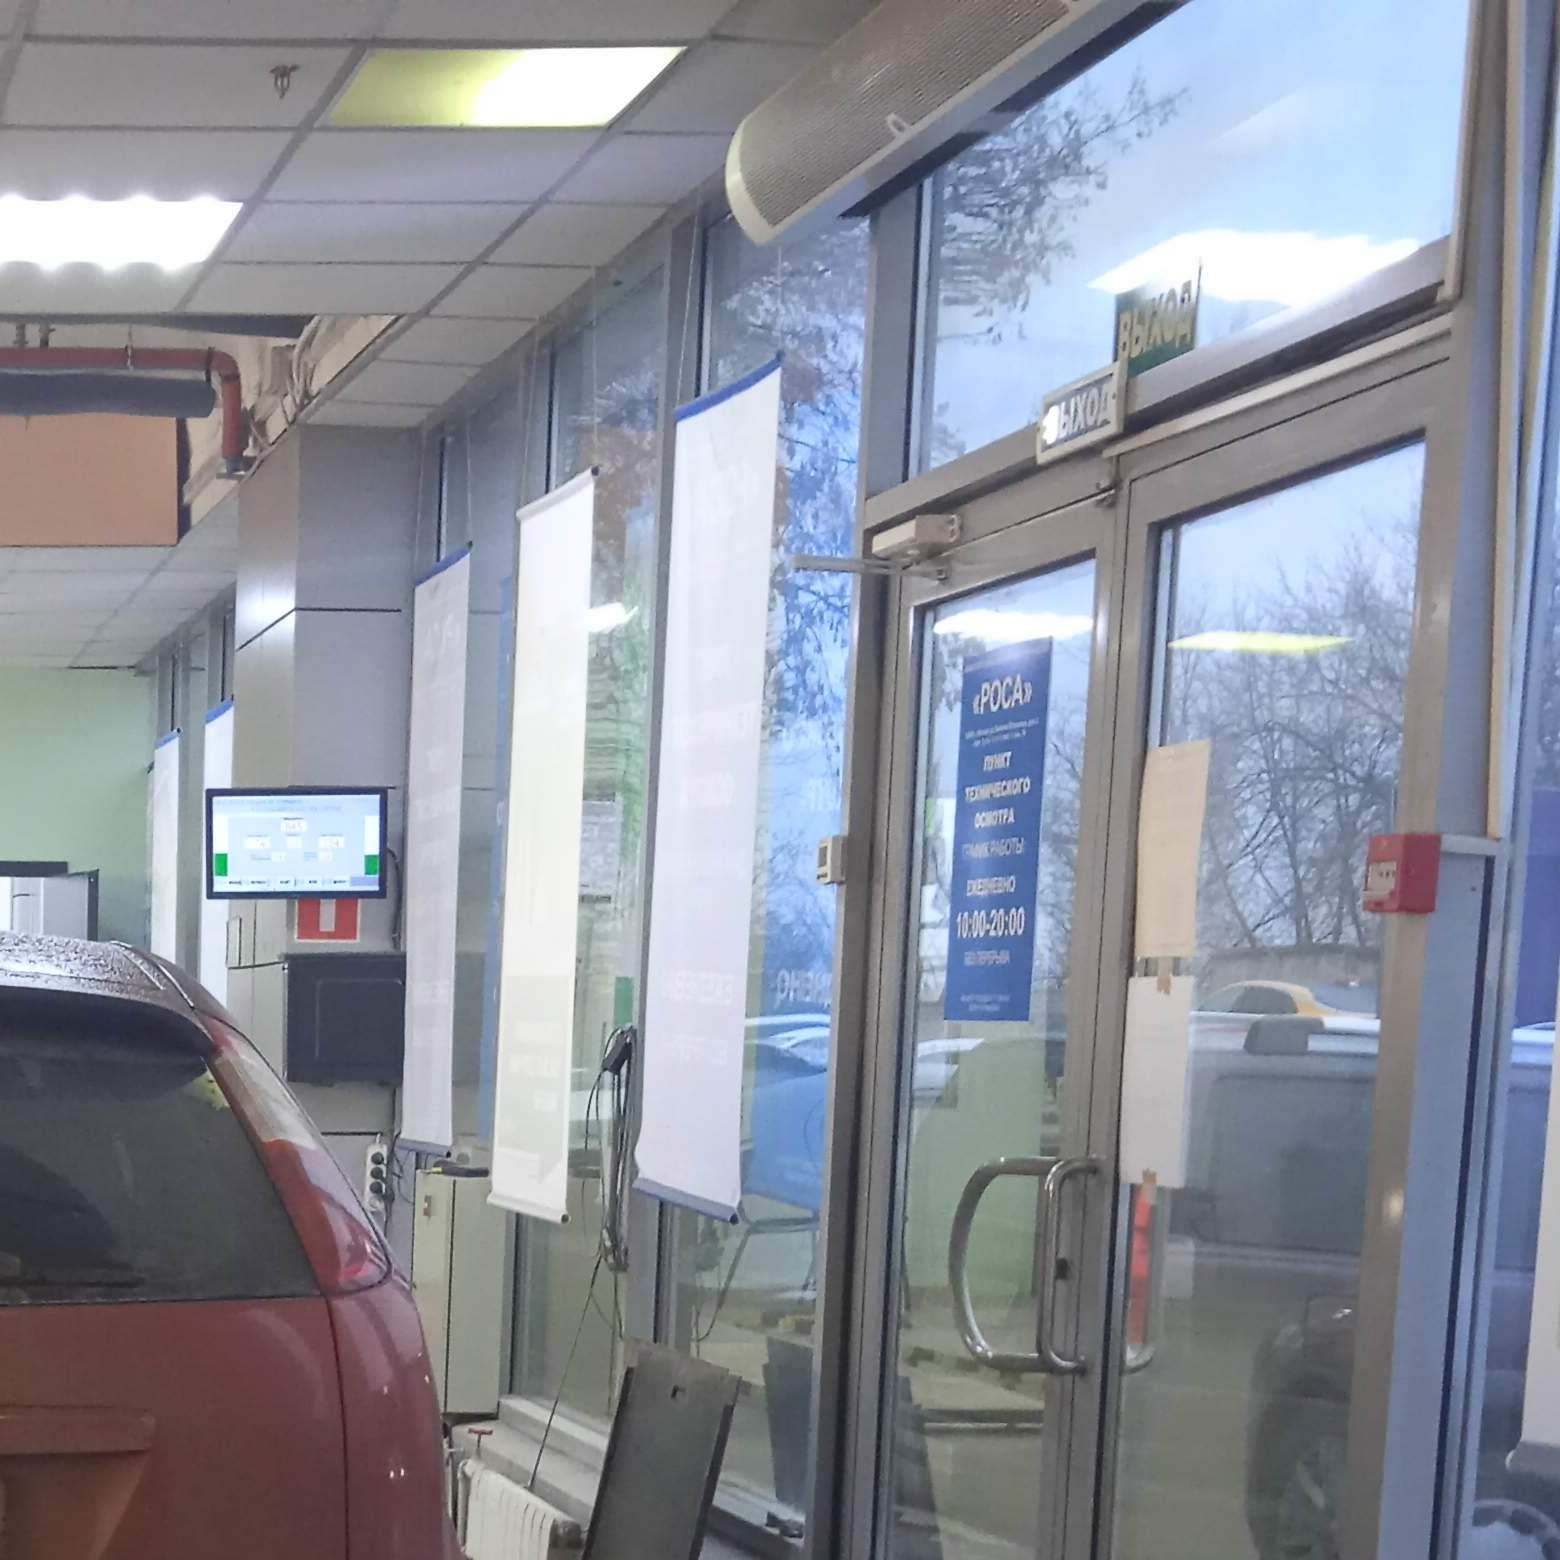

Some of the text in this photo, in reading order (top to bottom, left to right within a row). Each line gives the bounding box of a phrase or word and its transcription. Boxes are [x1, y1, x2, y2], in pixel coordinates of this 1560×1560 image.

[1119, 280, 1193, 358] ВЫХОД
[1043, 383, 1112, 445] ЫХОД
[972, 673, 1033, 715] «РОСА»
[956, 905, 1025, 938] 10:00-20:00
